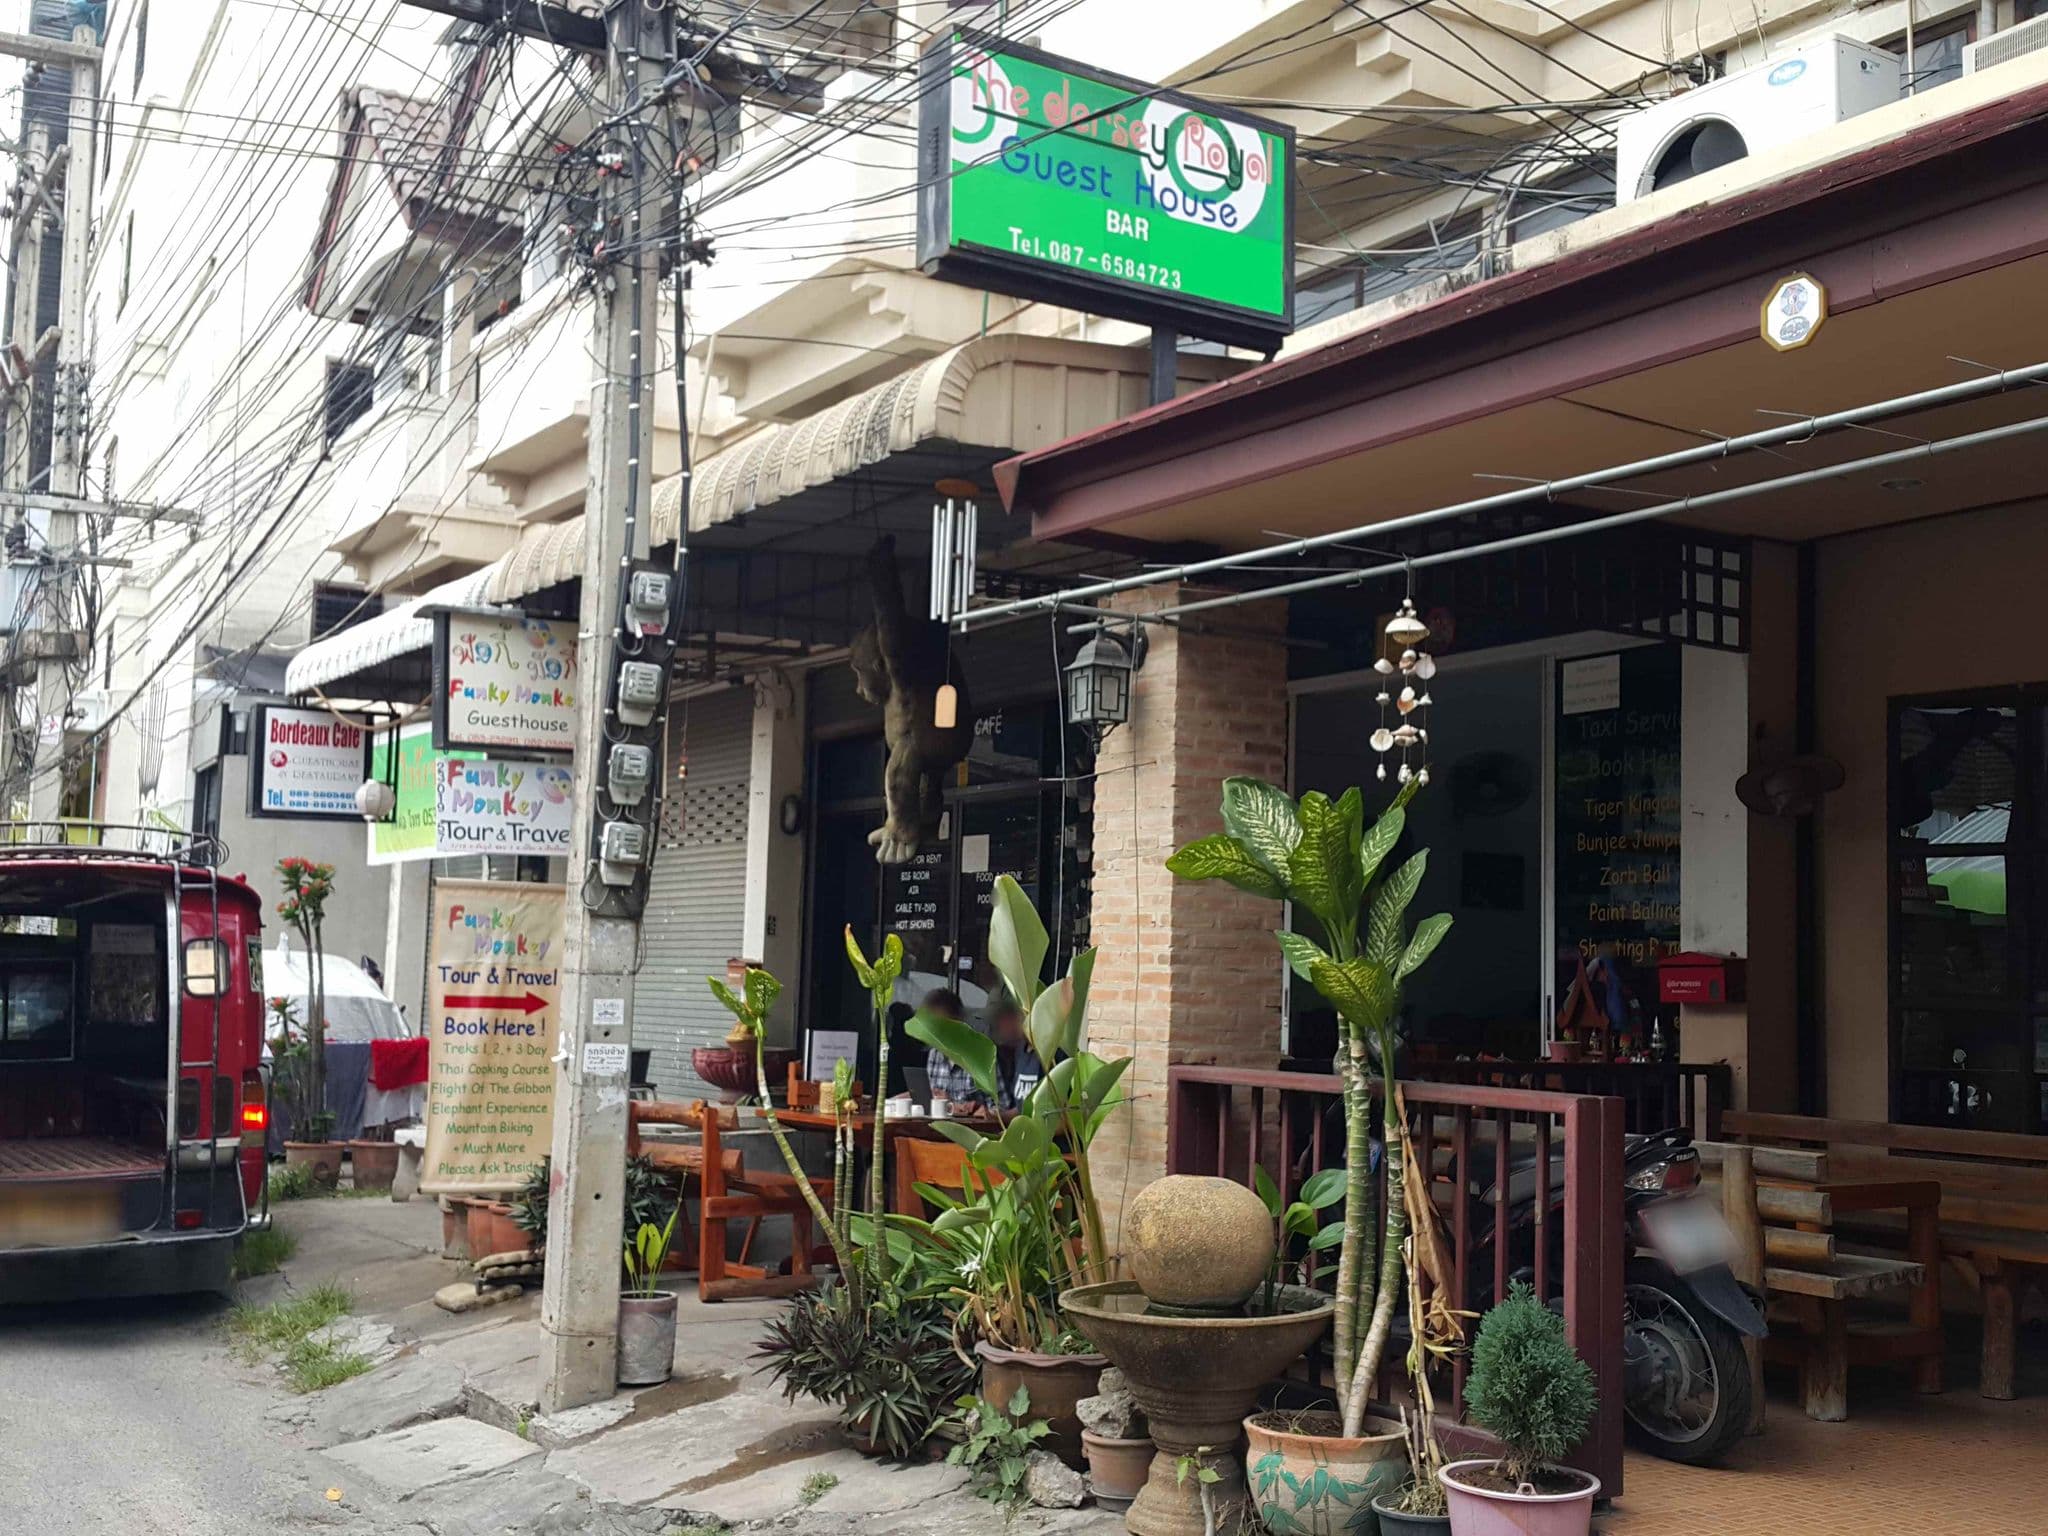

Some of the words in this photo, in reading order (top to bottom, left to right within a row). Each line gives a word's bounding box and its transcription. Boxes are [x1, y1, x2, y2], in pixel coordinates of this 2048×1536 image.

[965, 50, 1030, 117] The
[1184, 115, 1274, 191] Royal
[1001, 135, 1113, 198] Guest
[1136, 170, 1238, 228] House
[1106, 209, 1149, 241] BAR
[449, 679, 510, 707] Funky
[515, 684, 577, 712] Monke
[270, 717, 330, 747] Bordeaux
[468, 710, 569, 732] Guesthouse
[974, 707, 1003, 735] CAFÉ
[1580, 716, 1617, 737] Taxi
[1625, 709, 1681, 735] Servi
[1590, 753, 1633, 777] Book
[1640, 744, 1681, 771] Her
[447, 759, 524, 792] Funky
[452, 788, 543, 822] Monkey
[1584, 798, 1625, 822] Tiger
[1629, 793, 1681, 815] Kingdo
[441, 820, 494, 841] Tour
[496, 829, 507, 841] &
[506, 822, 570, 843] Trave
[1576, 832, 1628, 856] Bunjee
[976, 871, 994, 882] FOOD
[1600, 863, 1637, 887] Zorb
[1642, 863, 1671, 884] Ball
[895, 903, 913, 913] CABLE
[977, 894, 991, 904] POO
[449, 904, 516, 931] Funky
[1589, 902, 1626, 921] Paint
[895, 920, 908, 930] HOT
[909, 919, 935, 930] SHOWER
[474, 933, 550, 960] Monkey
[1579, 937, 1644, 962] Shting
[438, 966, 480, 984] Tour
[487, 967, 499, 984] &
[505, 968, 557, 985] Travel
[444, 1016, 488, 1035] Book
[494, 1017, 536, 1036] Here
[443, 1042, 478, 1054] Treks
[515, 1043, 524, 1054] 3
[526, 1044, 547, 1057] Day
[438, 1063, 464, 1075] Thai
[468, 1063, 509, 1078] Cooking
[512, 1063, 550, 1075] Course
[431, 1082, 467, 1097] Flight
[471, 1082, 485, 1094] Of
[490, 1082, 510, 1094] The
[513, 1082, 552, 1094] Gibbon
[431, 1102, 482, 1116] Elephant
[486, 1101, 548, 1116] Experience
[445, 1122, 497, 1134] Mountain
[499, 1121, 534, 1136] Biking
[463, 1143, 493, 1154] Much
[496, 1143, 526, 1153] More
[438, 1162, 475, 1175] Please
[479, 1161, 500, 1174] Ask
